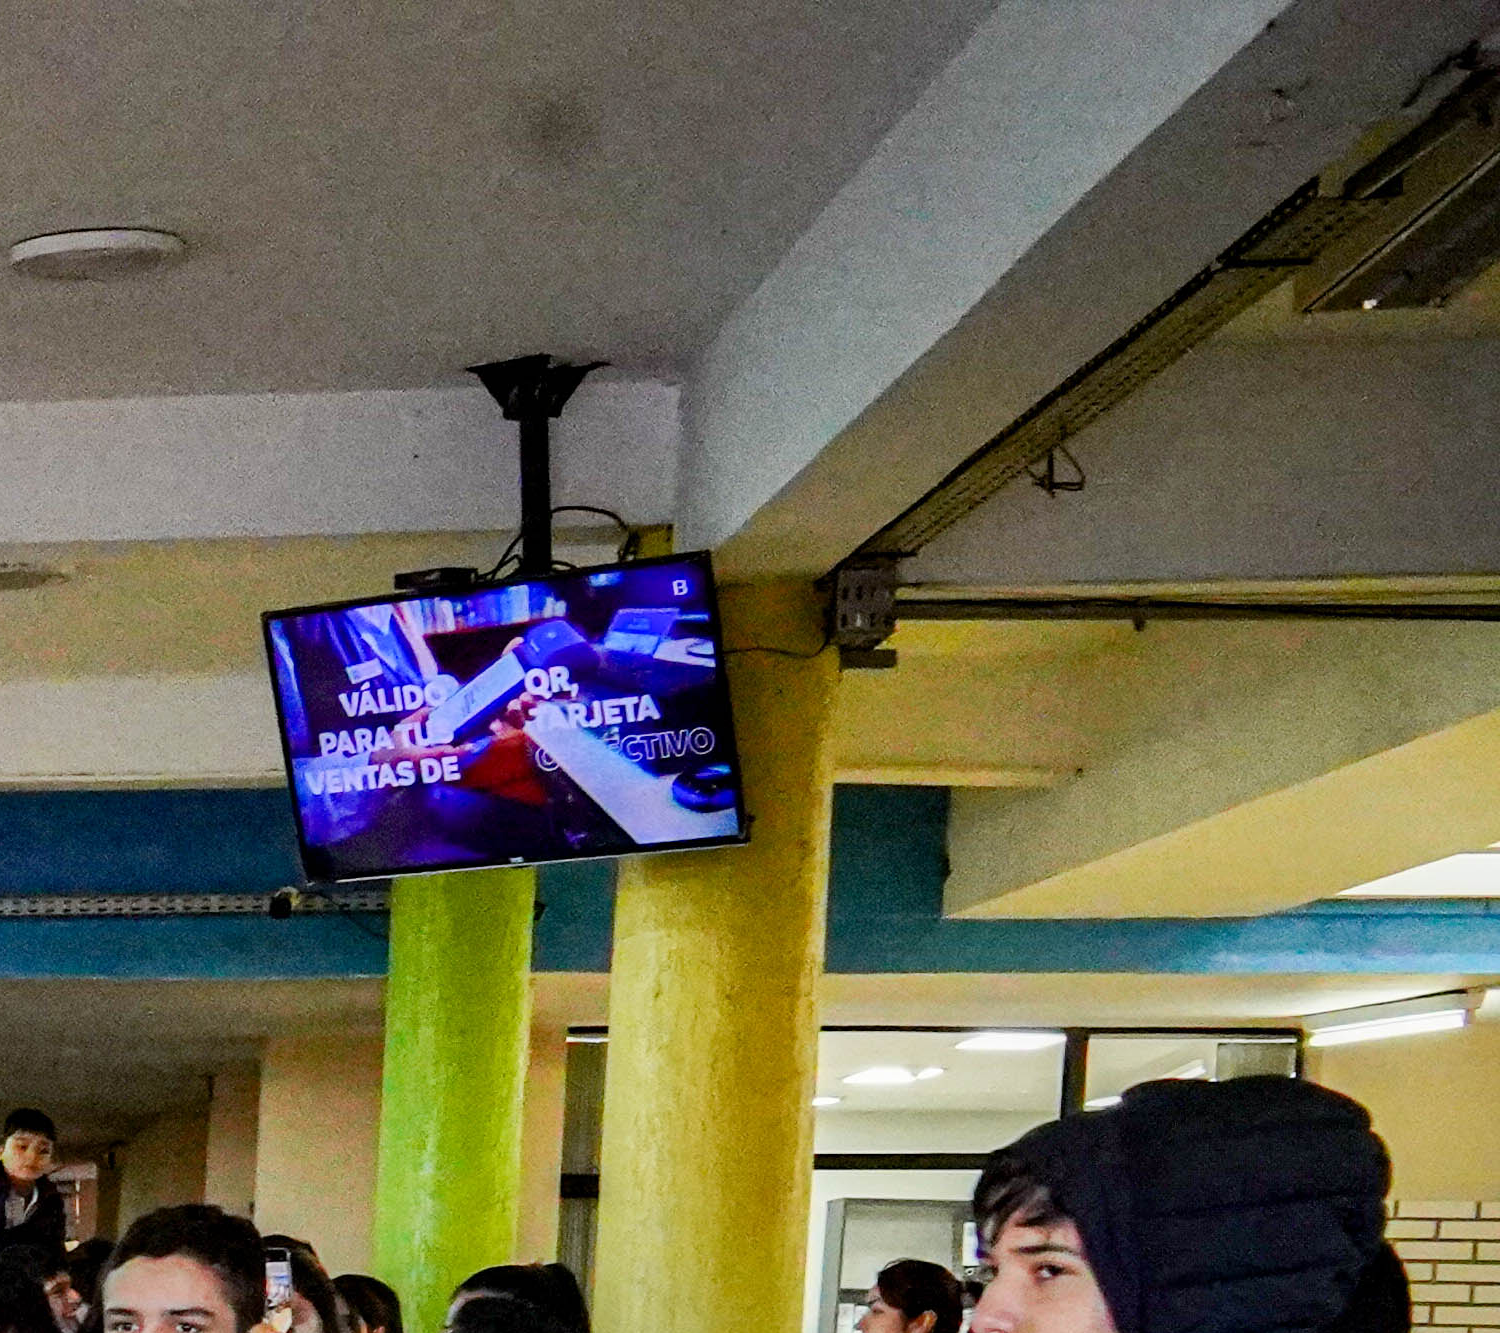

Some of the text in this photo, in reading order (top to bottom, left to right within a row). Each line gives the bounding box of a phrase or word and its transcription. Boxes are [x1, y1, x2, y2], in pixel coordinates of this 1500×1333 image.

[338, 682, 448, 718] VÁLIDO
[524, 665, 580, 701] QR,
[318, 725, 396, 758] PARA
[305, 755, 462, 796] VENTAS DE
